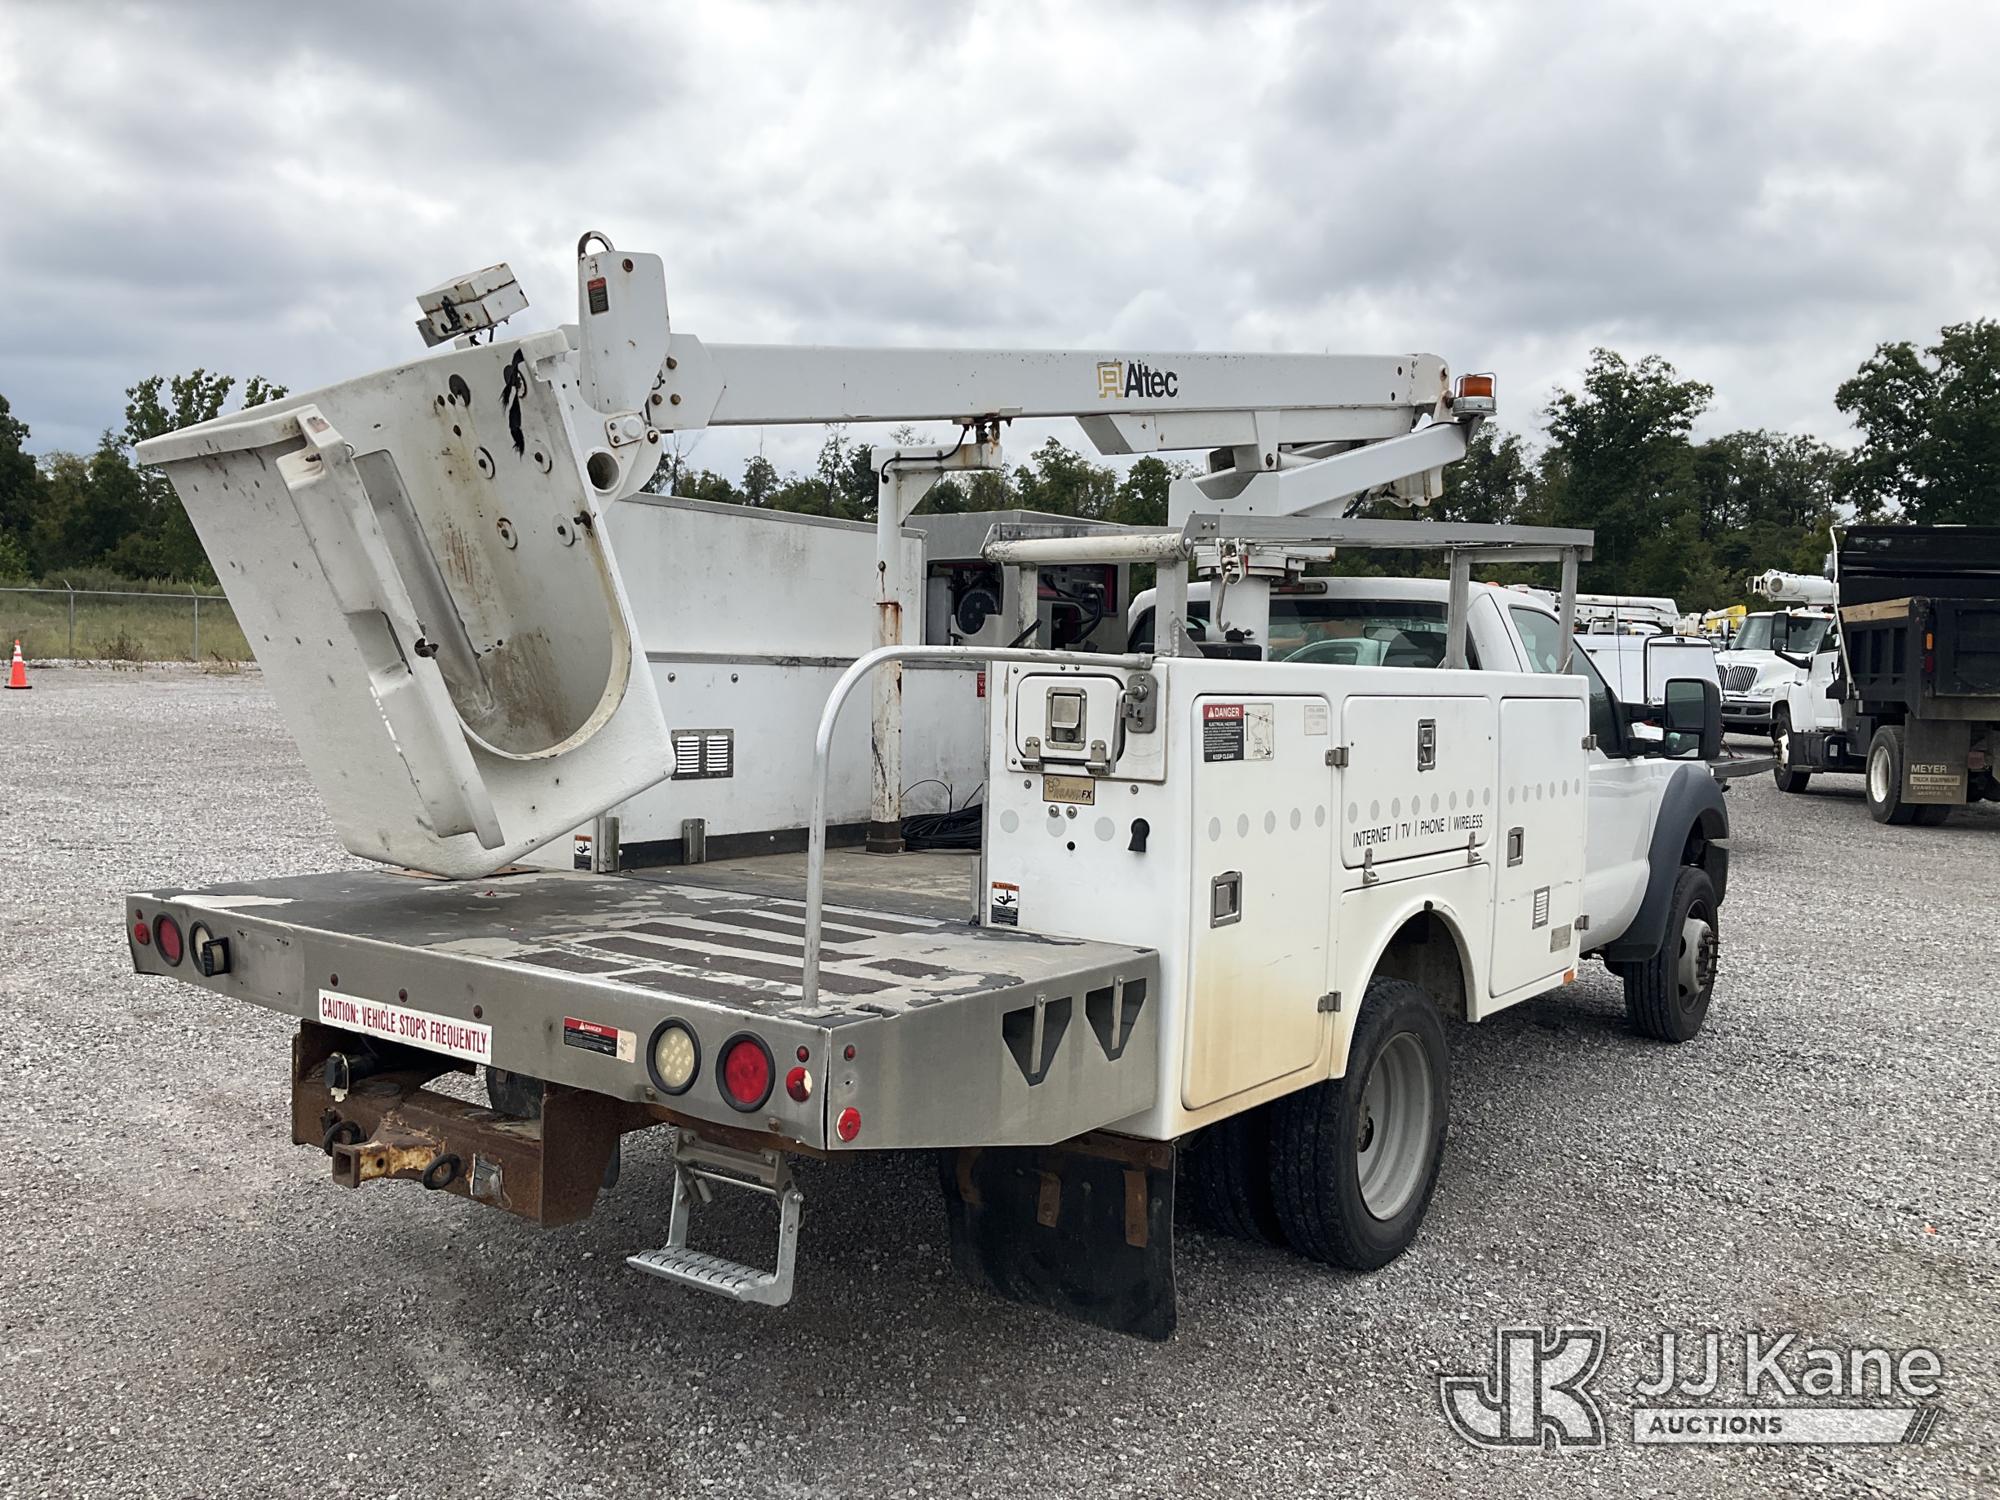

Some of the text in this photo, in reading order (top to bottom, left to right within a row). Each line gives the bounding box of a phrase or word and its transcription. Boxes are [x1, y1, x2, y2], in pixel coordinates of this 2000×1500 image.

[1124, 363, 1178, 398] Altec
[1214, 707, 1240, 718] DANGER
[1910, 764, 1948, 774] MEYER
[1353, 814, 1483, 848] INTERNET TV PHONE WIRELESS
[322, 997, 487, 1054] CAUTION: VEHICLE STOPS FREQUENTLY
